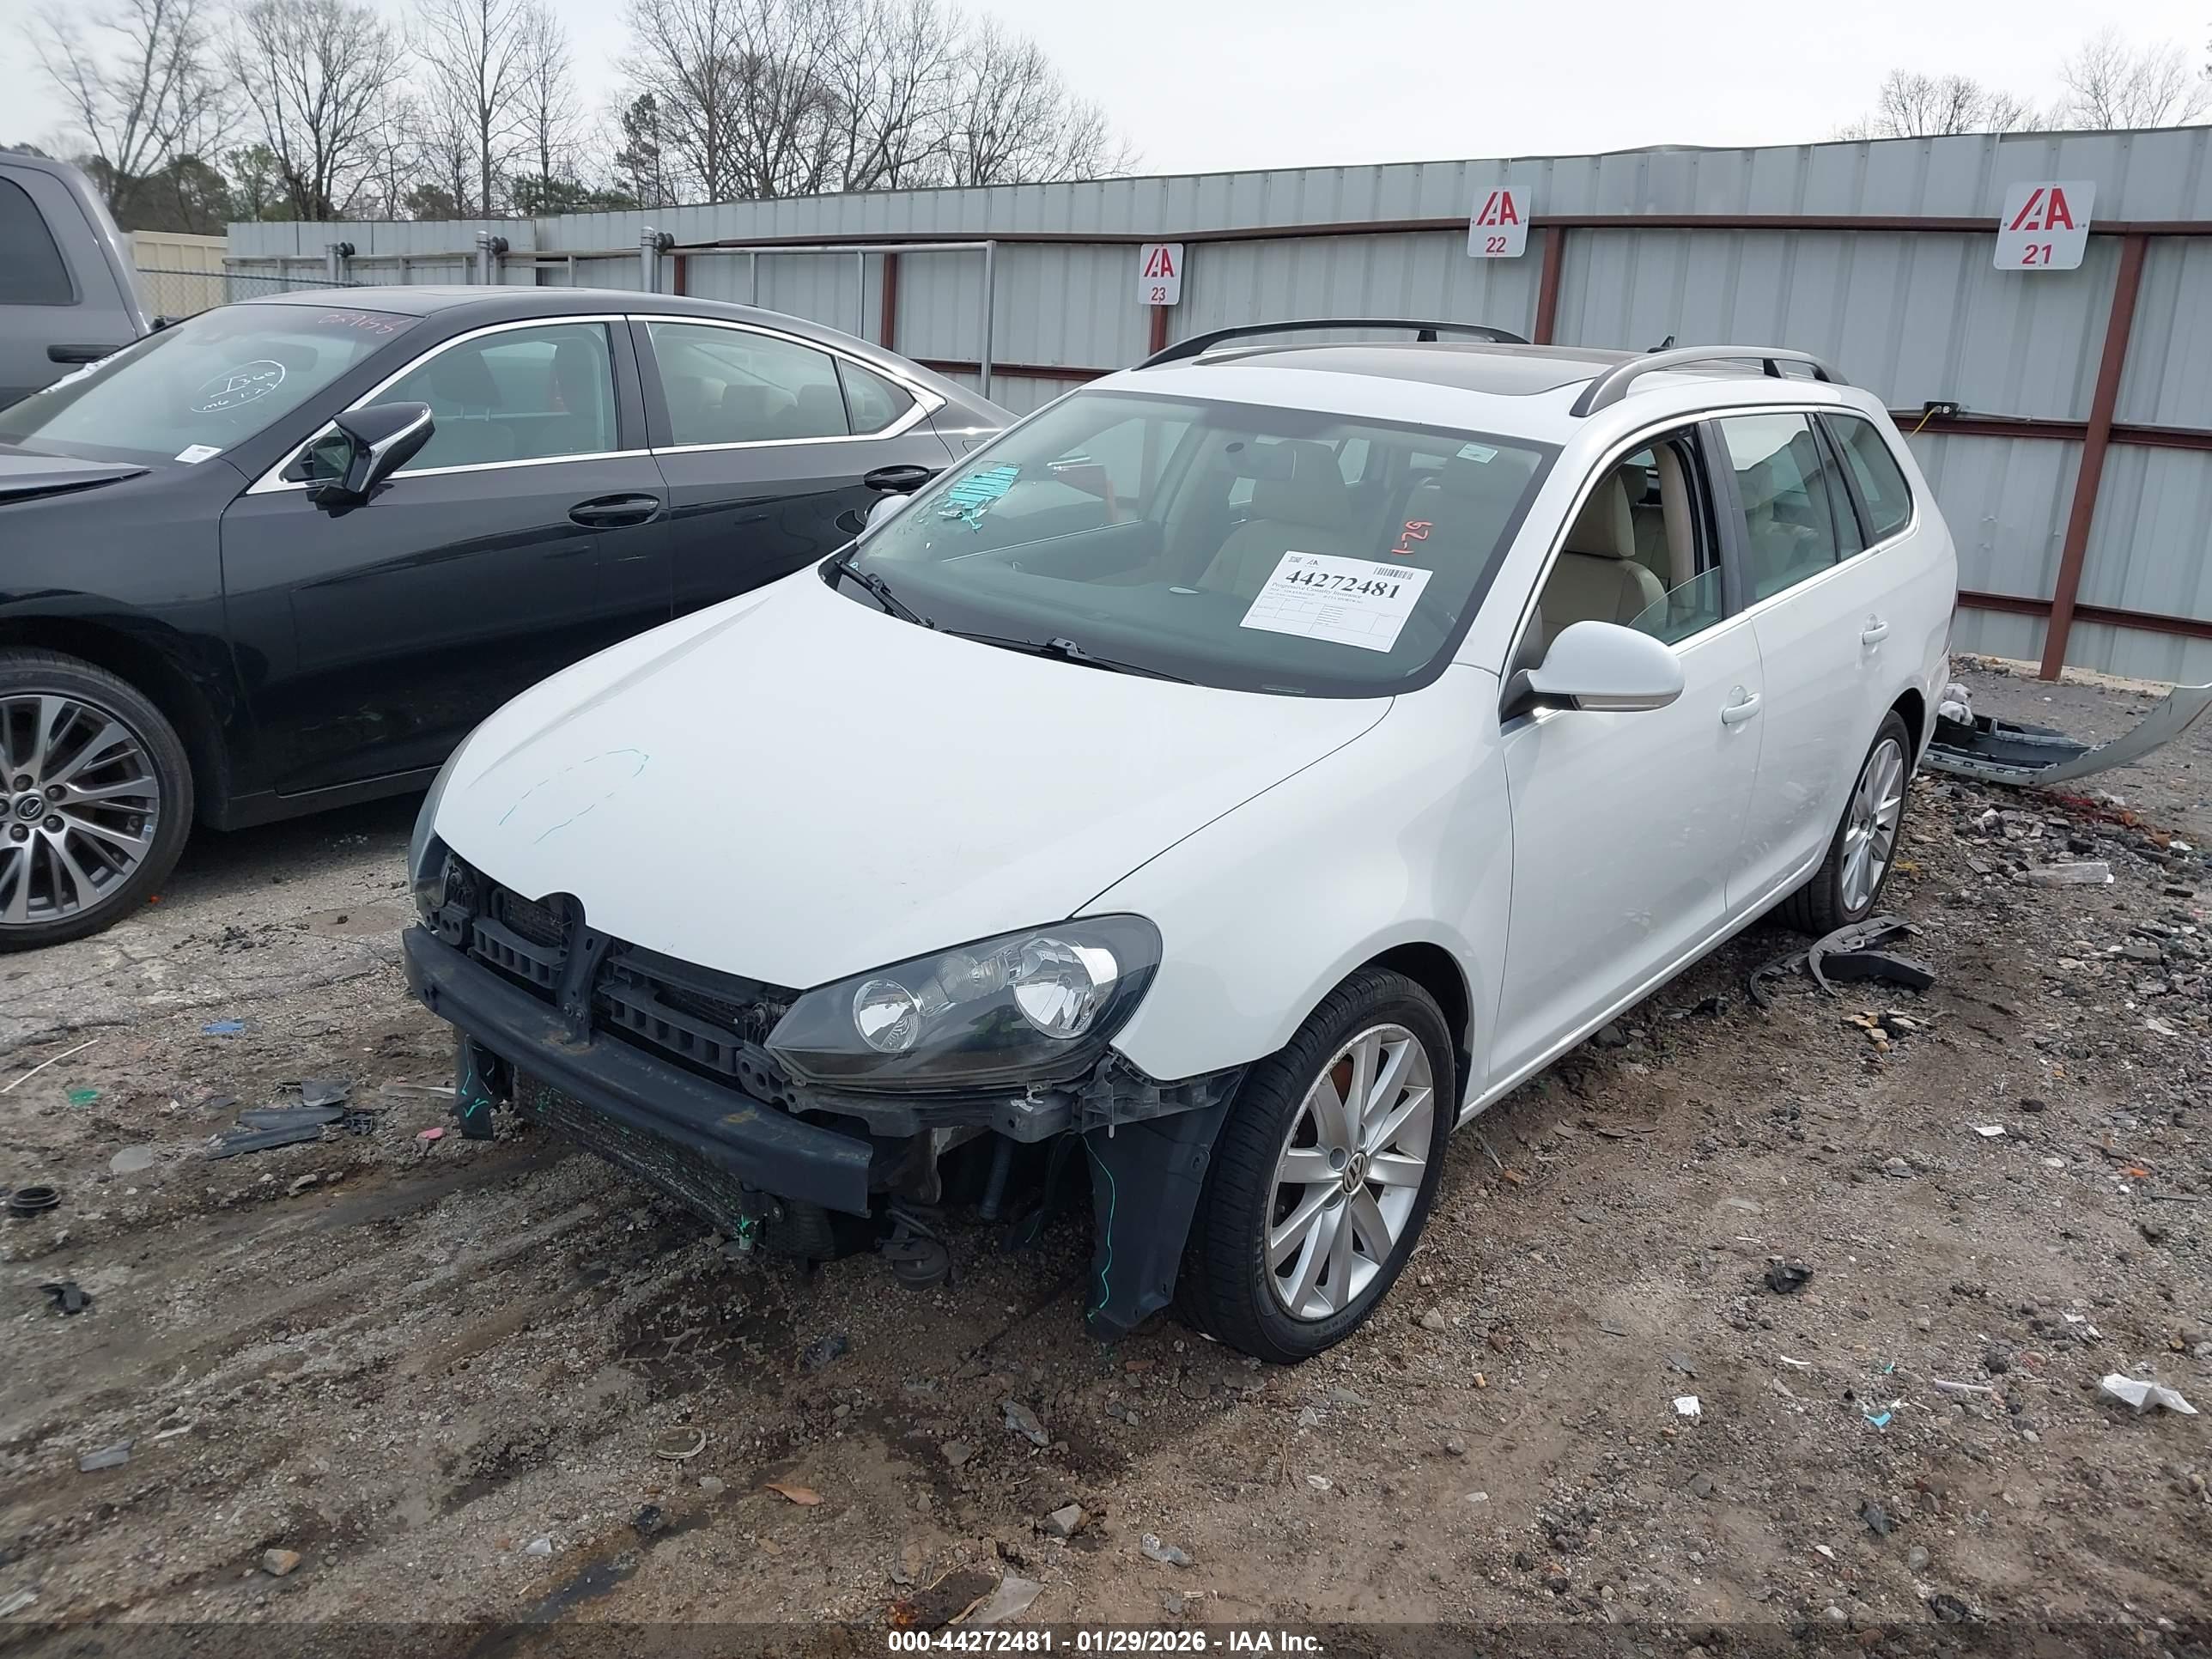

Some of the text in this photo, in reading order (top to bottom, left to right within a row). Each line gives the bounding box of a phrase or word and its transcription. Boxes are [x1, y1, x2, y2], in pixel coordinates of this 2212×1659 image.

[1486, 236, 1506, 252] 22
[2021, 244, 2052, 264] 21
[1151, 287, 1166, 301] 23
[1391, 520, 1433, 554] 1-29
[1285, 569, 1401, 599] 44272481
